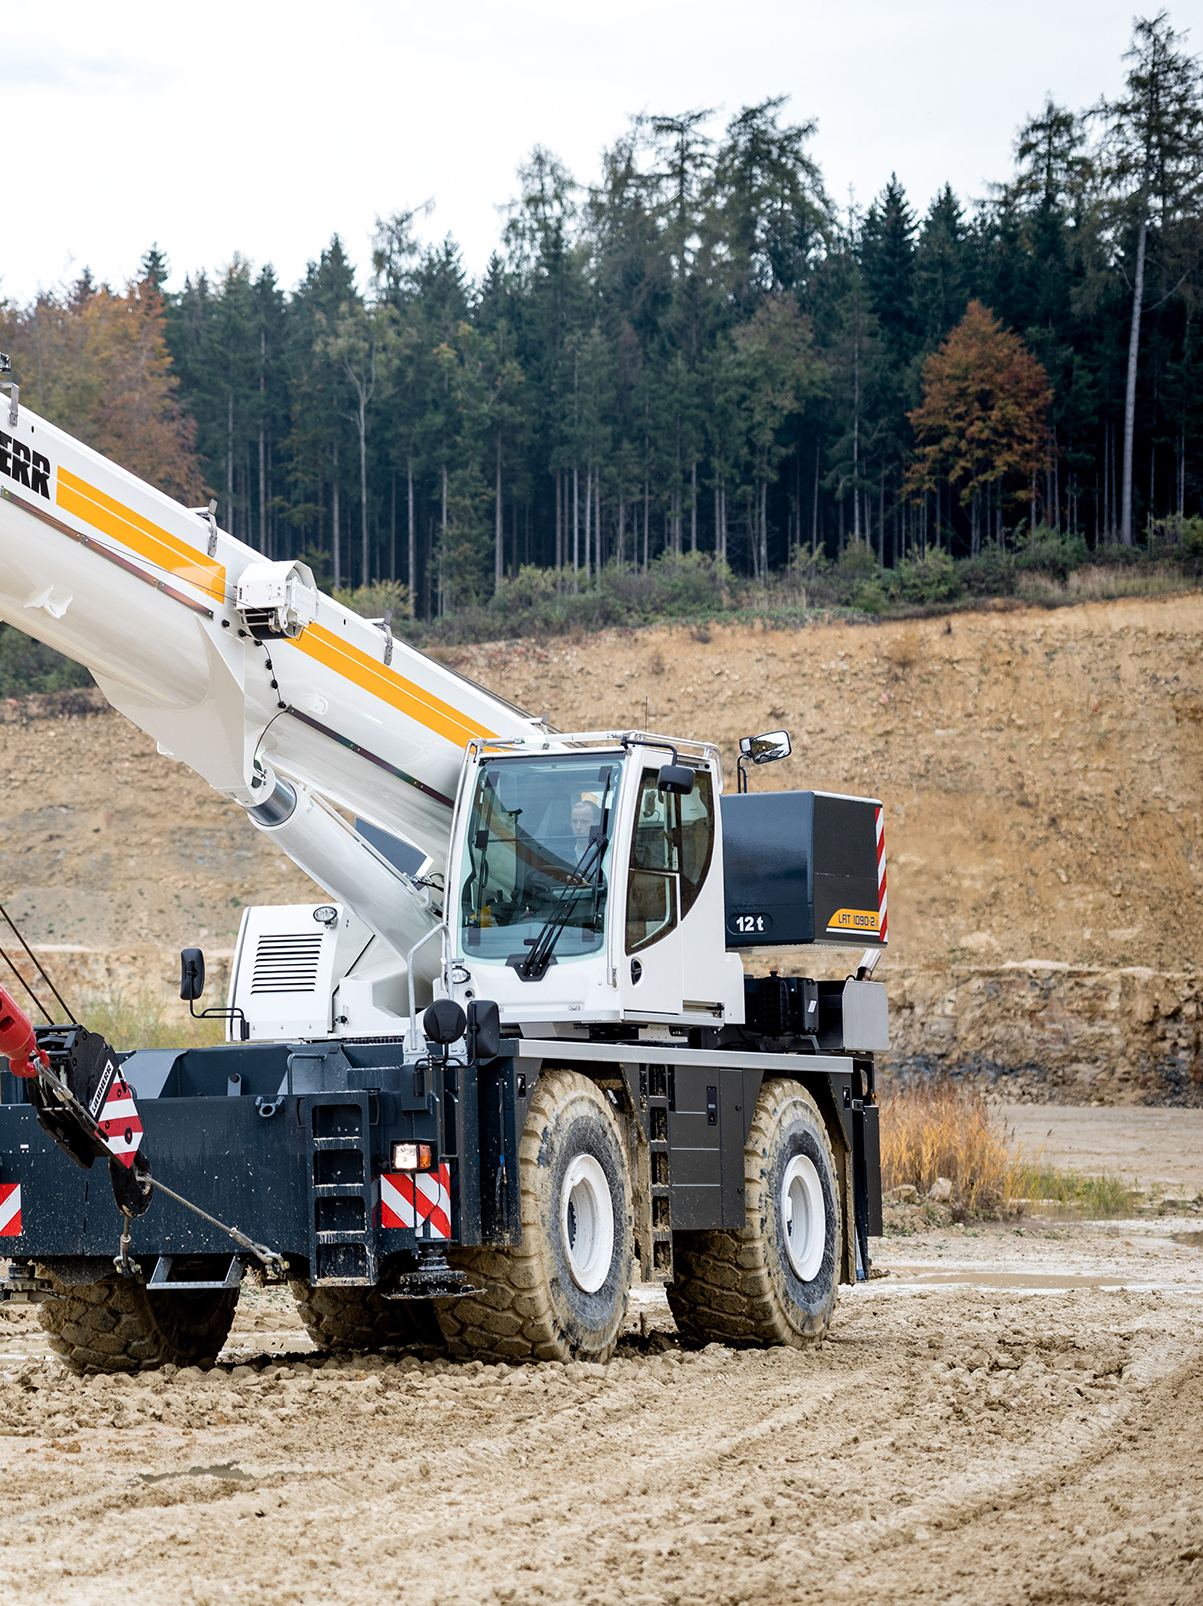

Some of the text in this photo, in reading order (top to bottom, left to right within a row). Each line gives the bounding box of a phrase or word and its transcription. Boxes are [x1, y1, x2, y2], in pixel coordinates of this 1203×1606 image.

[736, 916, 764, 932] 12 t
[838, 913, 851, 924] LRT
[91, 1064, 112, 1113] LIEBHERR
